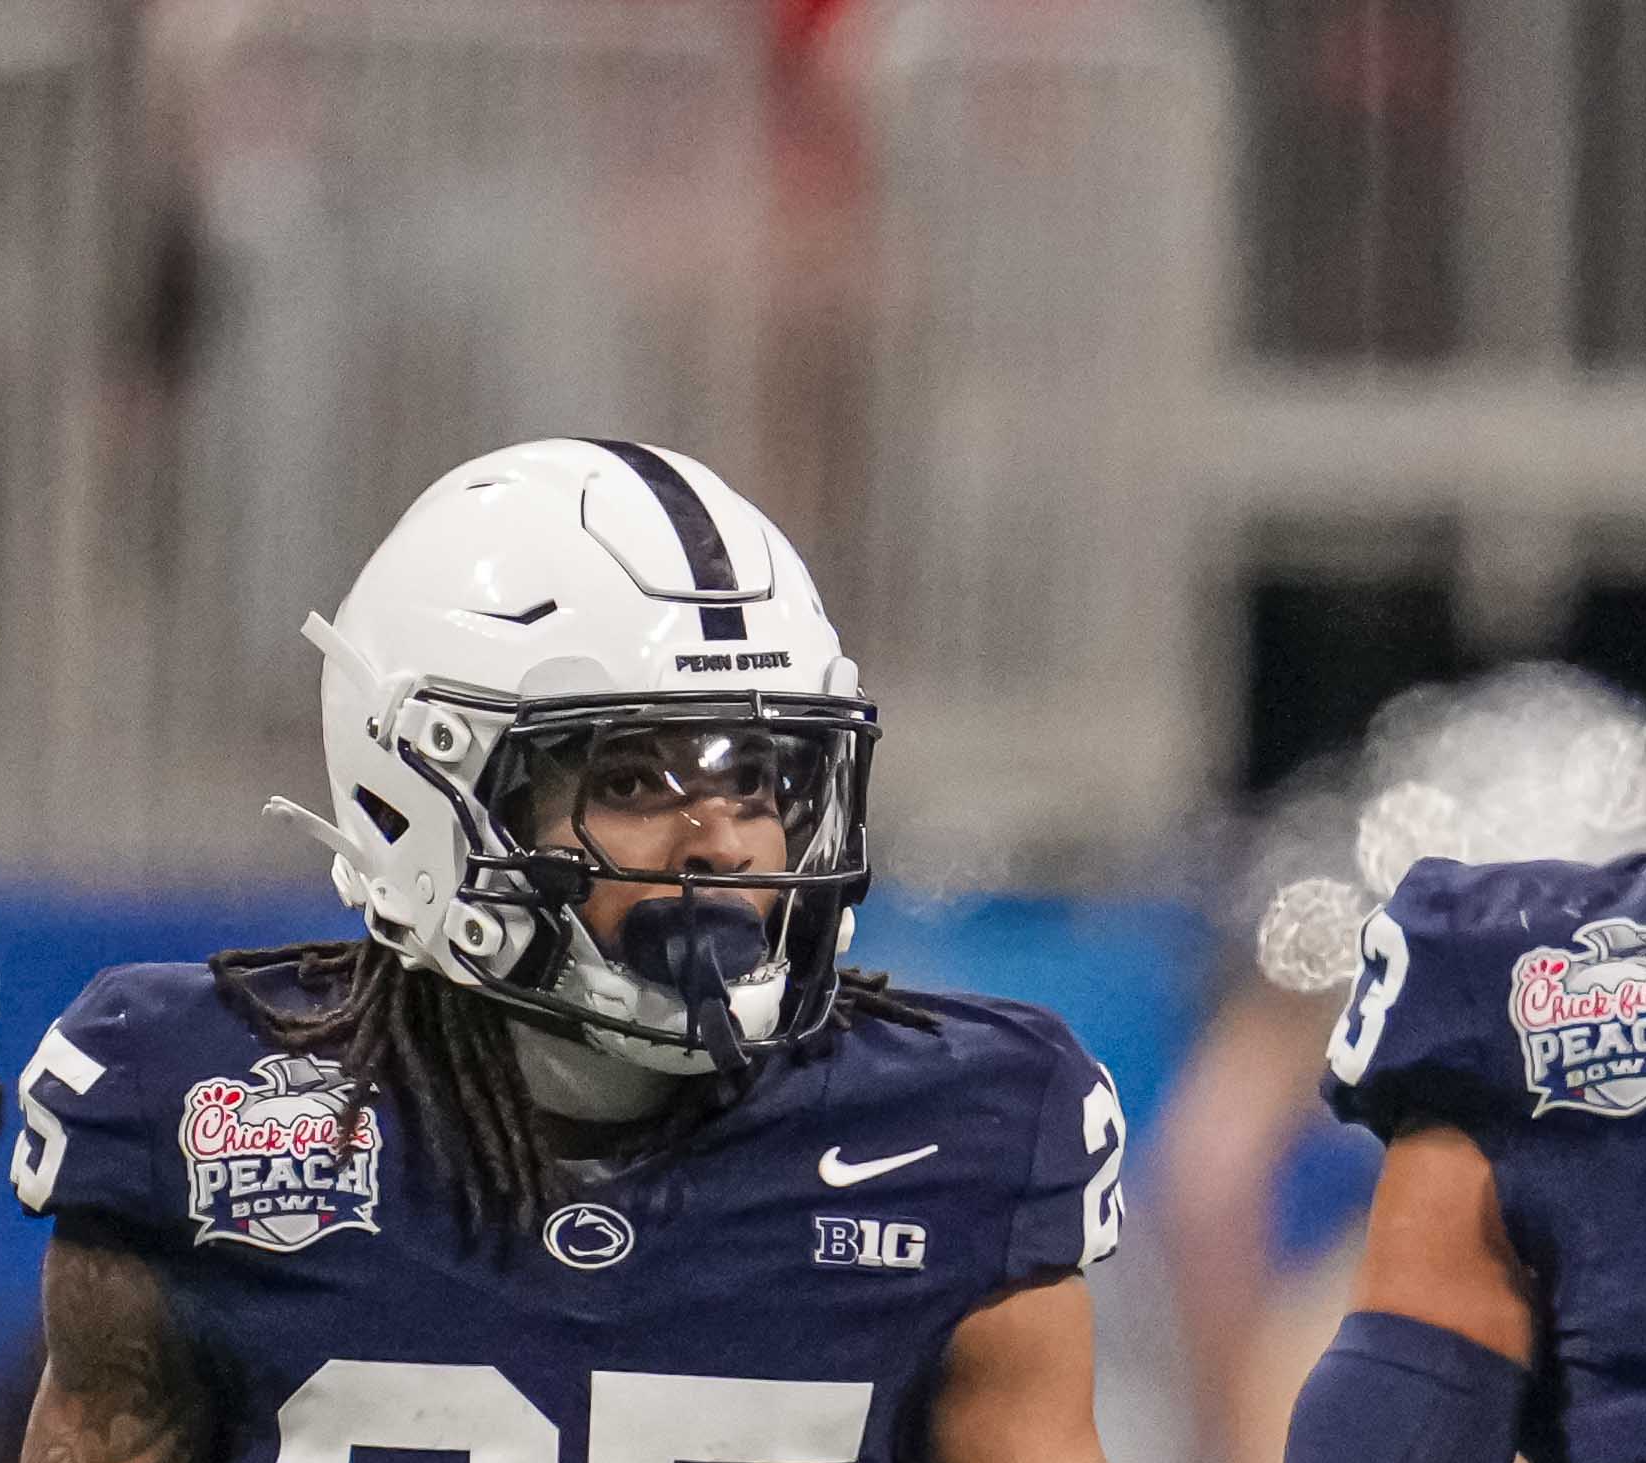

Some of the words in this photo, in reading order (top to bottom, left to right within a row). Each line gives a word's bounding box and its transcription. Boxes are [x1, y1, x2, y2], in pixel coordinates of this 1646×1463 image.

[675, 654, 732, 672] PENN
[736, 651, 793, 671] STATE
[1326, 904, 1410, 1087] 3
[10, 1017, 108, 1213] 5
[1076, 1062, 1127, 1268] 2
[195, 1152, 373, 1211] PEACH
[231, 1195, 336, 1219] BOWL
